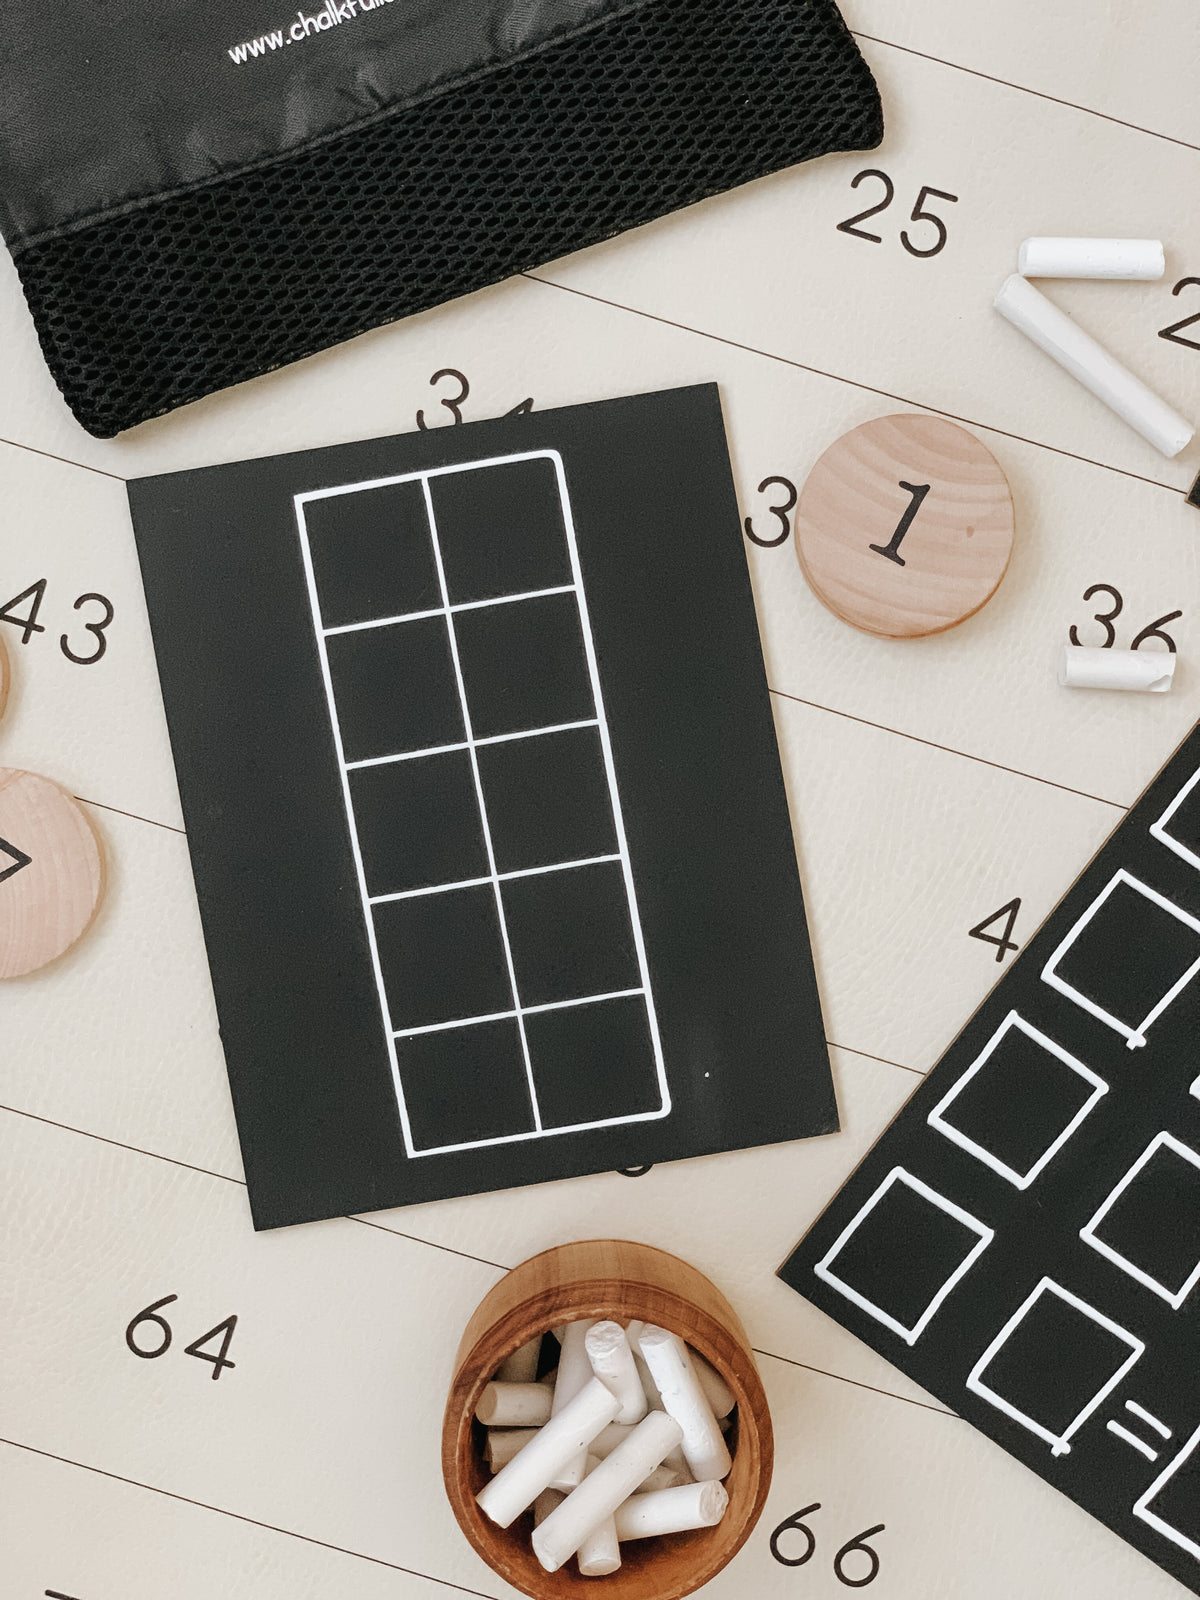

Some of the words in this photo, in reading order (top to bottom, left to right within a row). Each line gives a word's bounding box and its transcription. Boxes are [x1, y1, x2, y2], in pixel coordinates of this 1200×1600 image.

[228, 0, 395, 64] www.chalkfu
[836, 168, 959, 258] 25
[416, 368, 535, 431] 3
[744, 476, 798, 548] 3
[868, 480, 931, 567] 1
[0, 578, 115, 665] 43
[1069, 583, 1183, 653] 36
[968, 897, 1022, 963] 4
[125, 1293, 238, 1381] 64
[769, 1502, 886, 1588] 66
